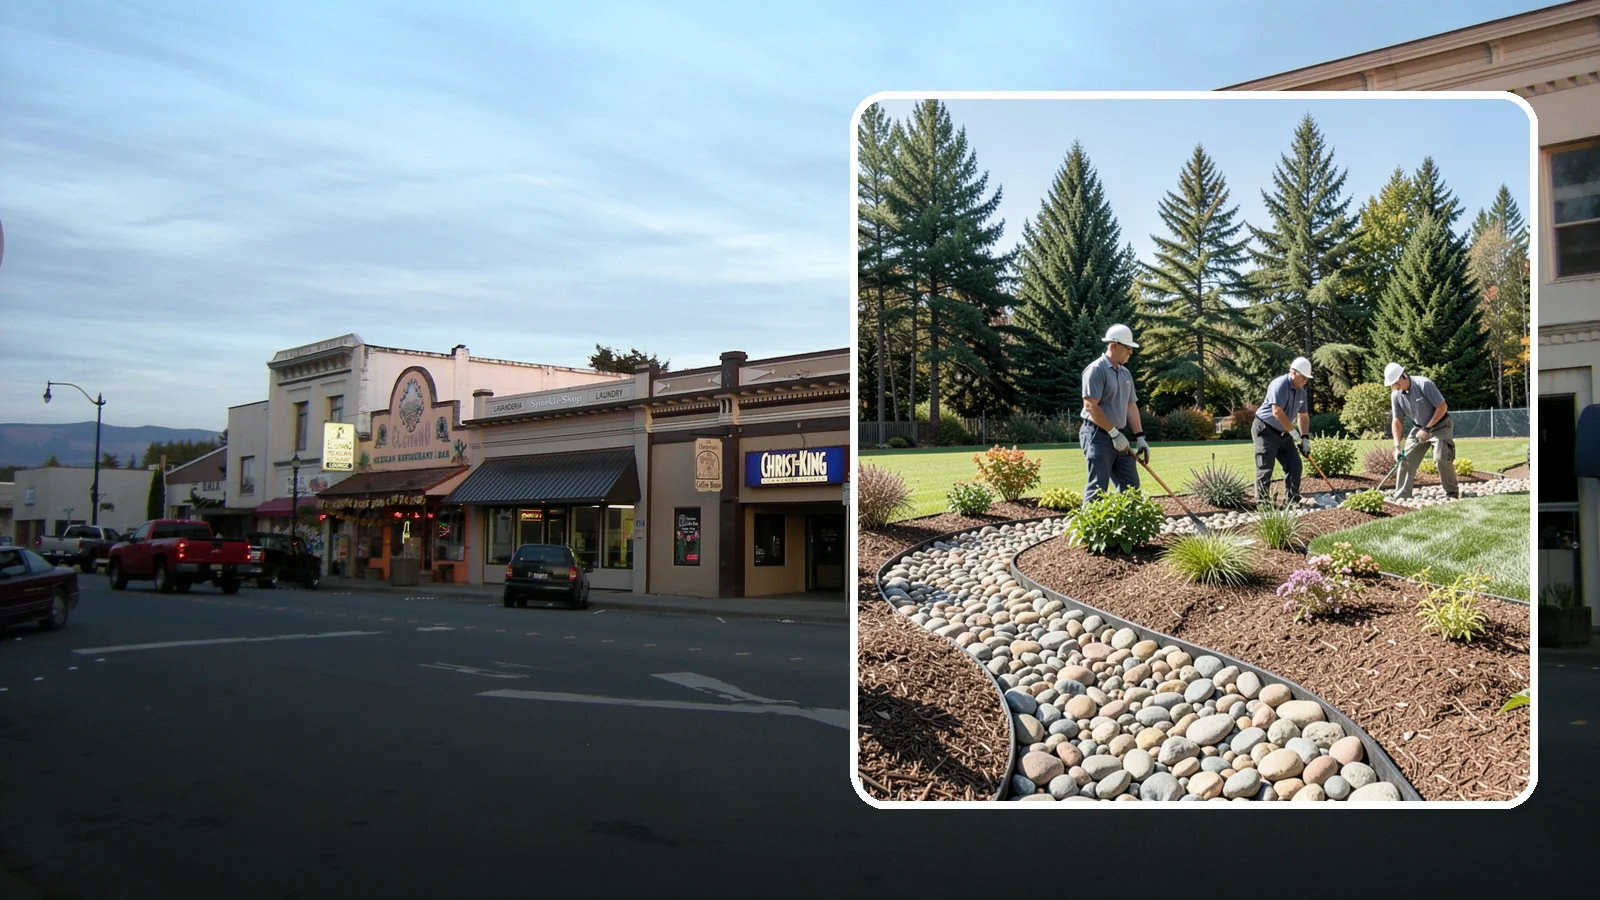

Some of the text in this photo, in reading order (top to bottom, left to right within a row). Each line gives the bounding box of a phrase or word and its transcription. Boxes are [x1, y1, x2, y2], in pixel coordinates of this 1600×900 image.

[596, 389, 623, 400] LAUNDRY
[493, 402, 522, 412] LAVANDERIA
[530, 395, 583, 409] Sparkle Shop
[373, 450, 450, 464] MEXICAN RESTAURANT BAR
[760, 449, 827, 478] CHRIST KING
[696, 480, 722, 489] Coffee House
